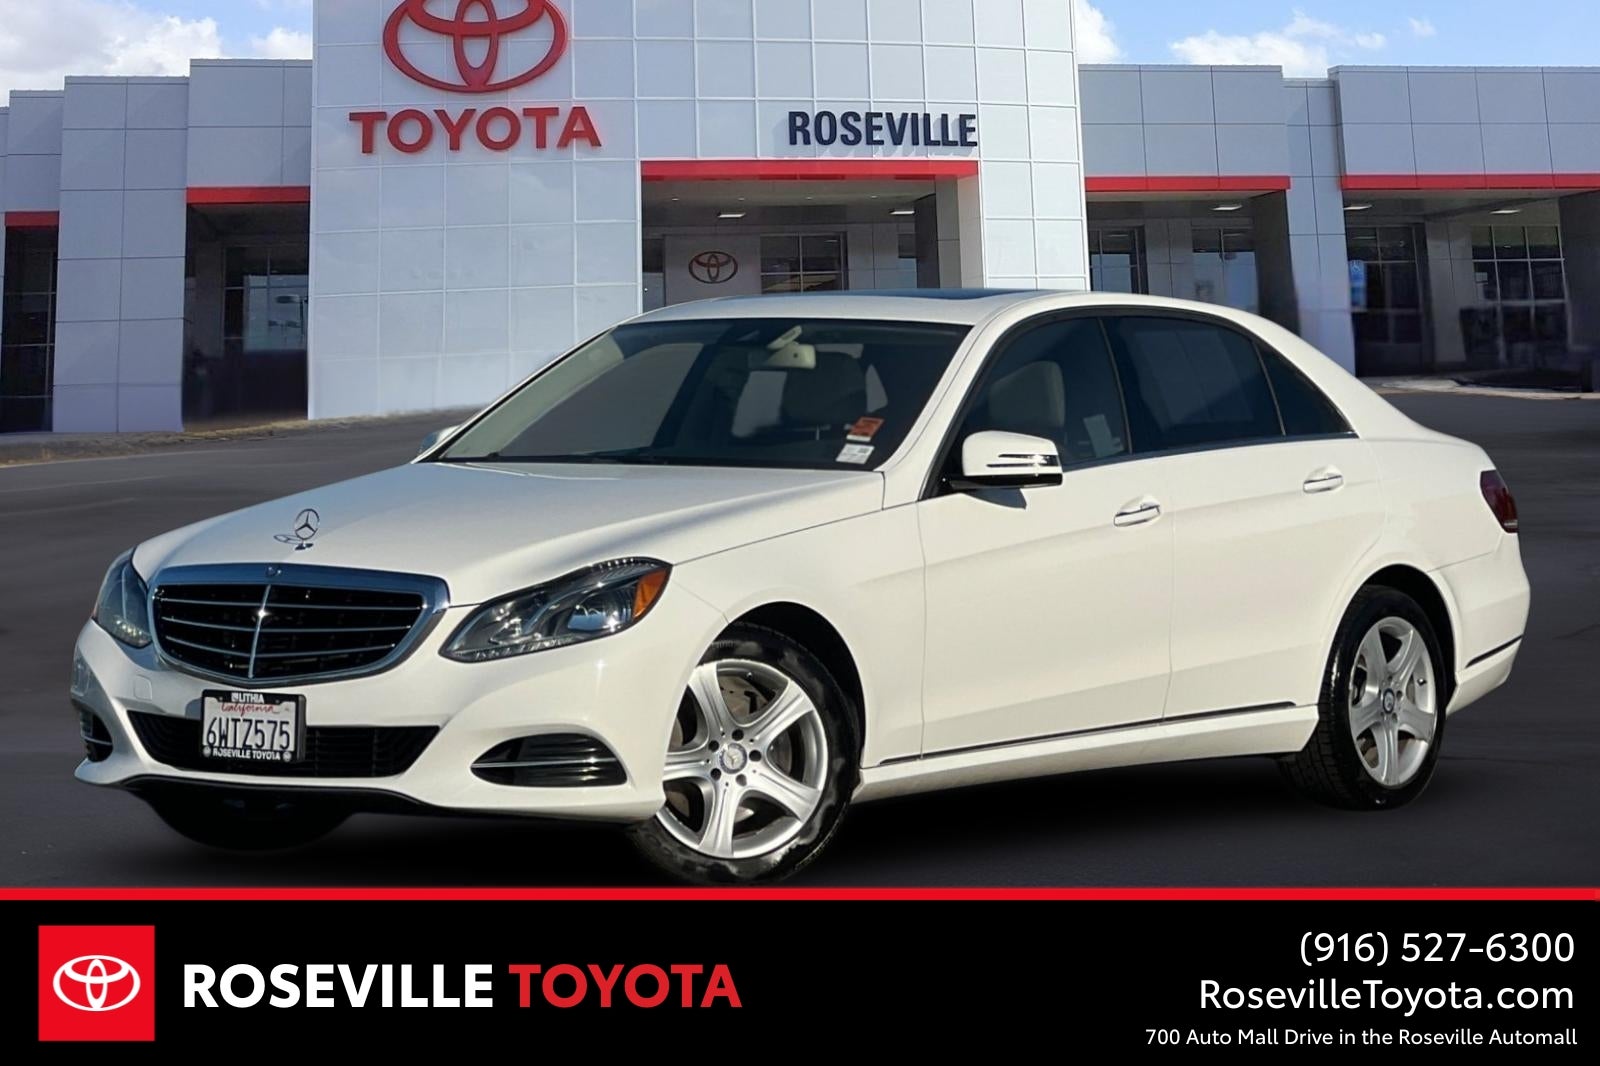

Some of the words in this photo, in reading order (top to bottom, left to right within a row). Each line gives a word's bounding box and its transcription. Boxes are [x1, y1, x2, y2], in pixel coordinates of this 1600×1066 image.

[349, 106, 602, 154] TOYOTA
[788, 110, 979, 147] ROSEVILLE
[240, 692, 265, 704] LITHIA
[221, 703, 275, 717] California
[212, 748, 251, 759] ROSEVILLE
[252, 750, 281, 761] TOYOTA
